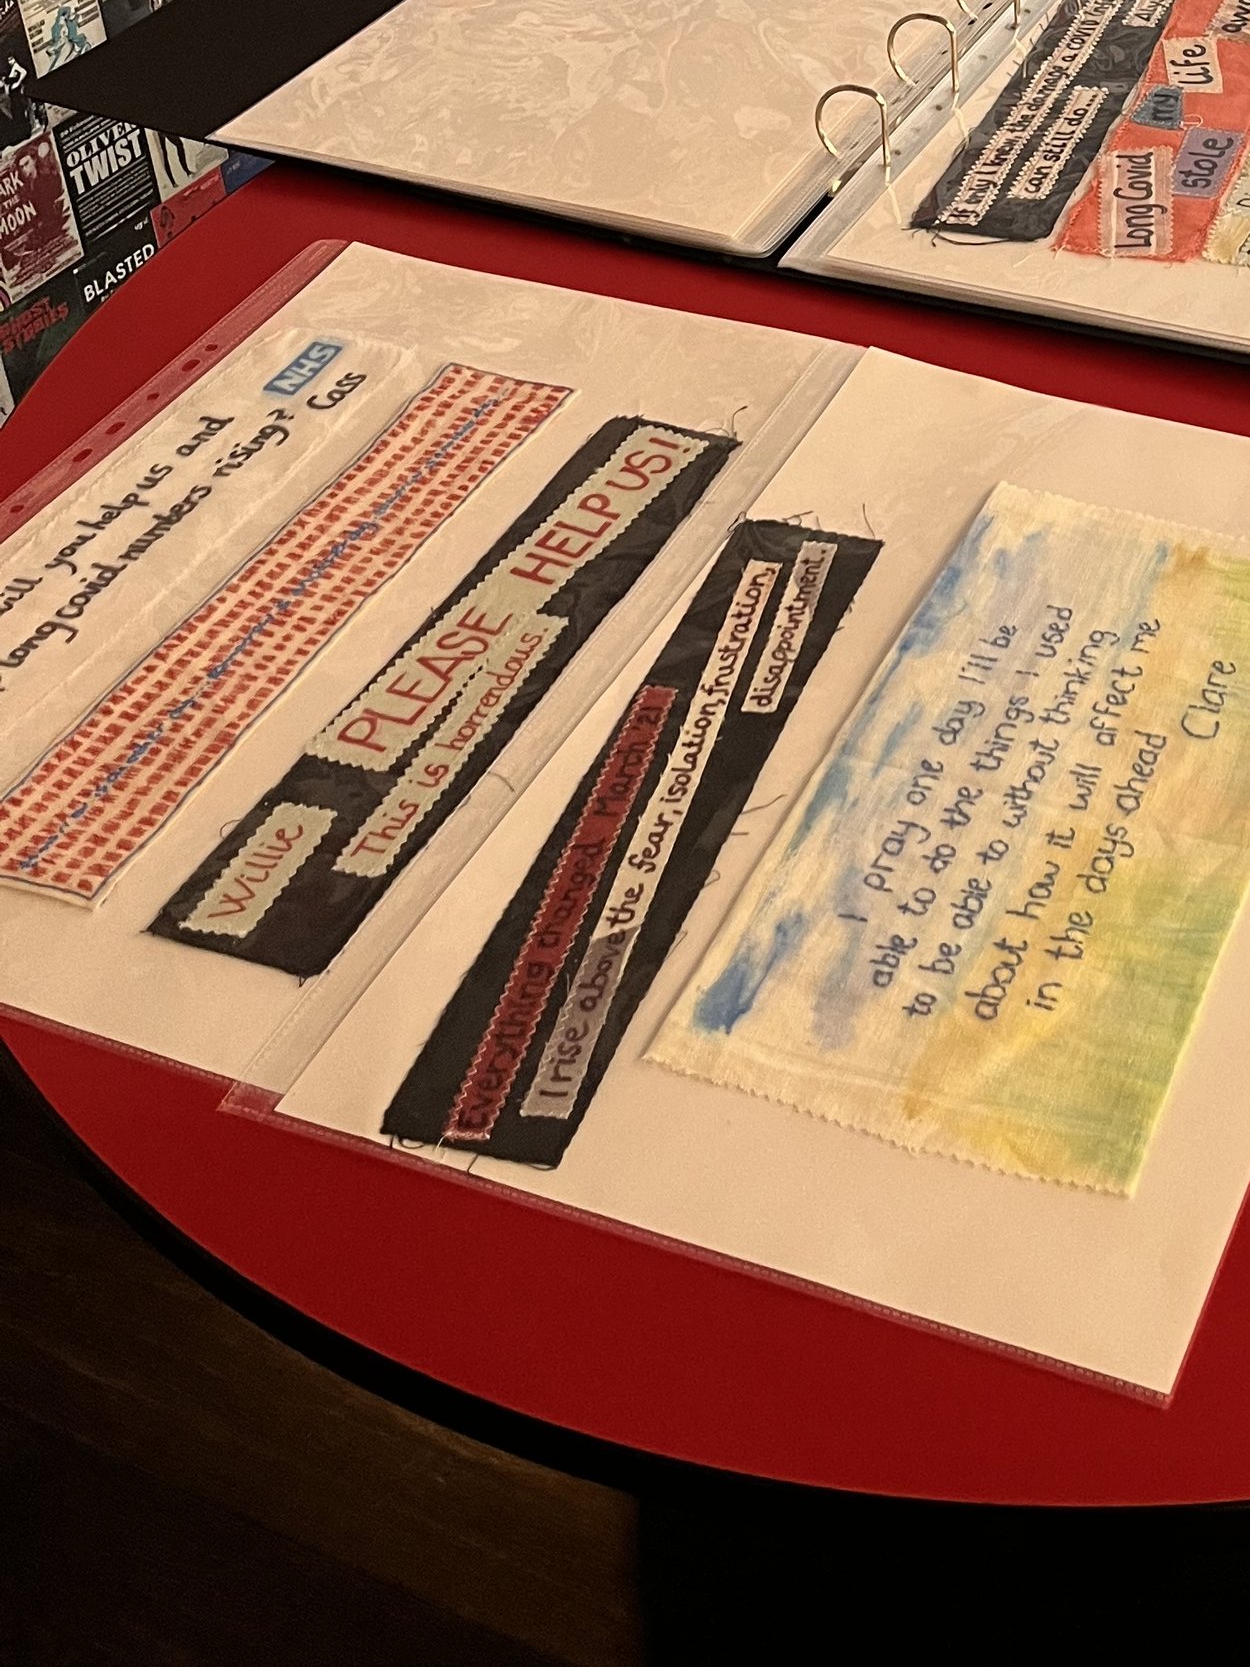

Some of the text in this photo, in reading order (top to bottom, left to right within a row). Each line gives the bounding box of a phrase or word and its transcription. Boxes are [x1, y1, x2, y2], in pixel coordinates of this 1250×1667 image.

[1024, 92, 1100, 194] can still do...
[1113, 151, 1154, 200] Covid
[1151, 94, 1179, 122] my
[84, 243, 155, 303] BLASTED
[1113, 199, 1168, 249] Long
[269, 343, 339, 393] NHS
[307, 371, 367, 410] Cass
[45, 415, 235, 576] you help us and
[56, 562, 128, 620] covid
[119, 485, 212, 562] numbers
[212, 407, 295, 479] rising?
[337, 606, 513, 753] PLEASE
[510, 493, 614, 586] HELP
[605, 436, 691, 504] US!
[350, 625, 550, 860] This is horrendous.
[539, 840, 605, 949] changed
[594, 740, 647, 818] March
[550, 549, 827, 1083] rise above the fear, isolation, frustration, disappointment.
[864, 820, 932, 893] pray
[906, 758, 944, 807] one
[932, 699, 985, 746] day
[990, 624, 1017, 649] be
[869, 604, 1073, 988] able to do the things used
[902, 629, 1120, 1018] to be able to without thinking
[964, 618, 1161, 1021] about how it will affect me
[1026, 659, 1237, 1011] in the days ahead Clare
[207, 823, 305, 921] Willie
